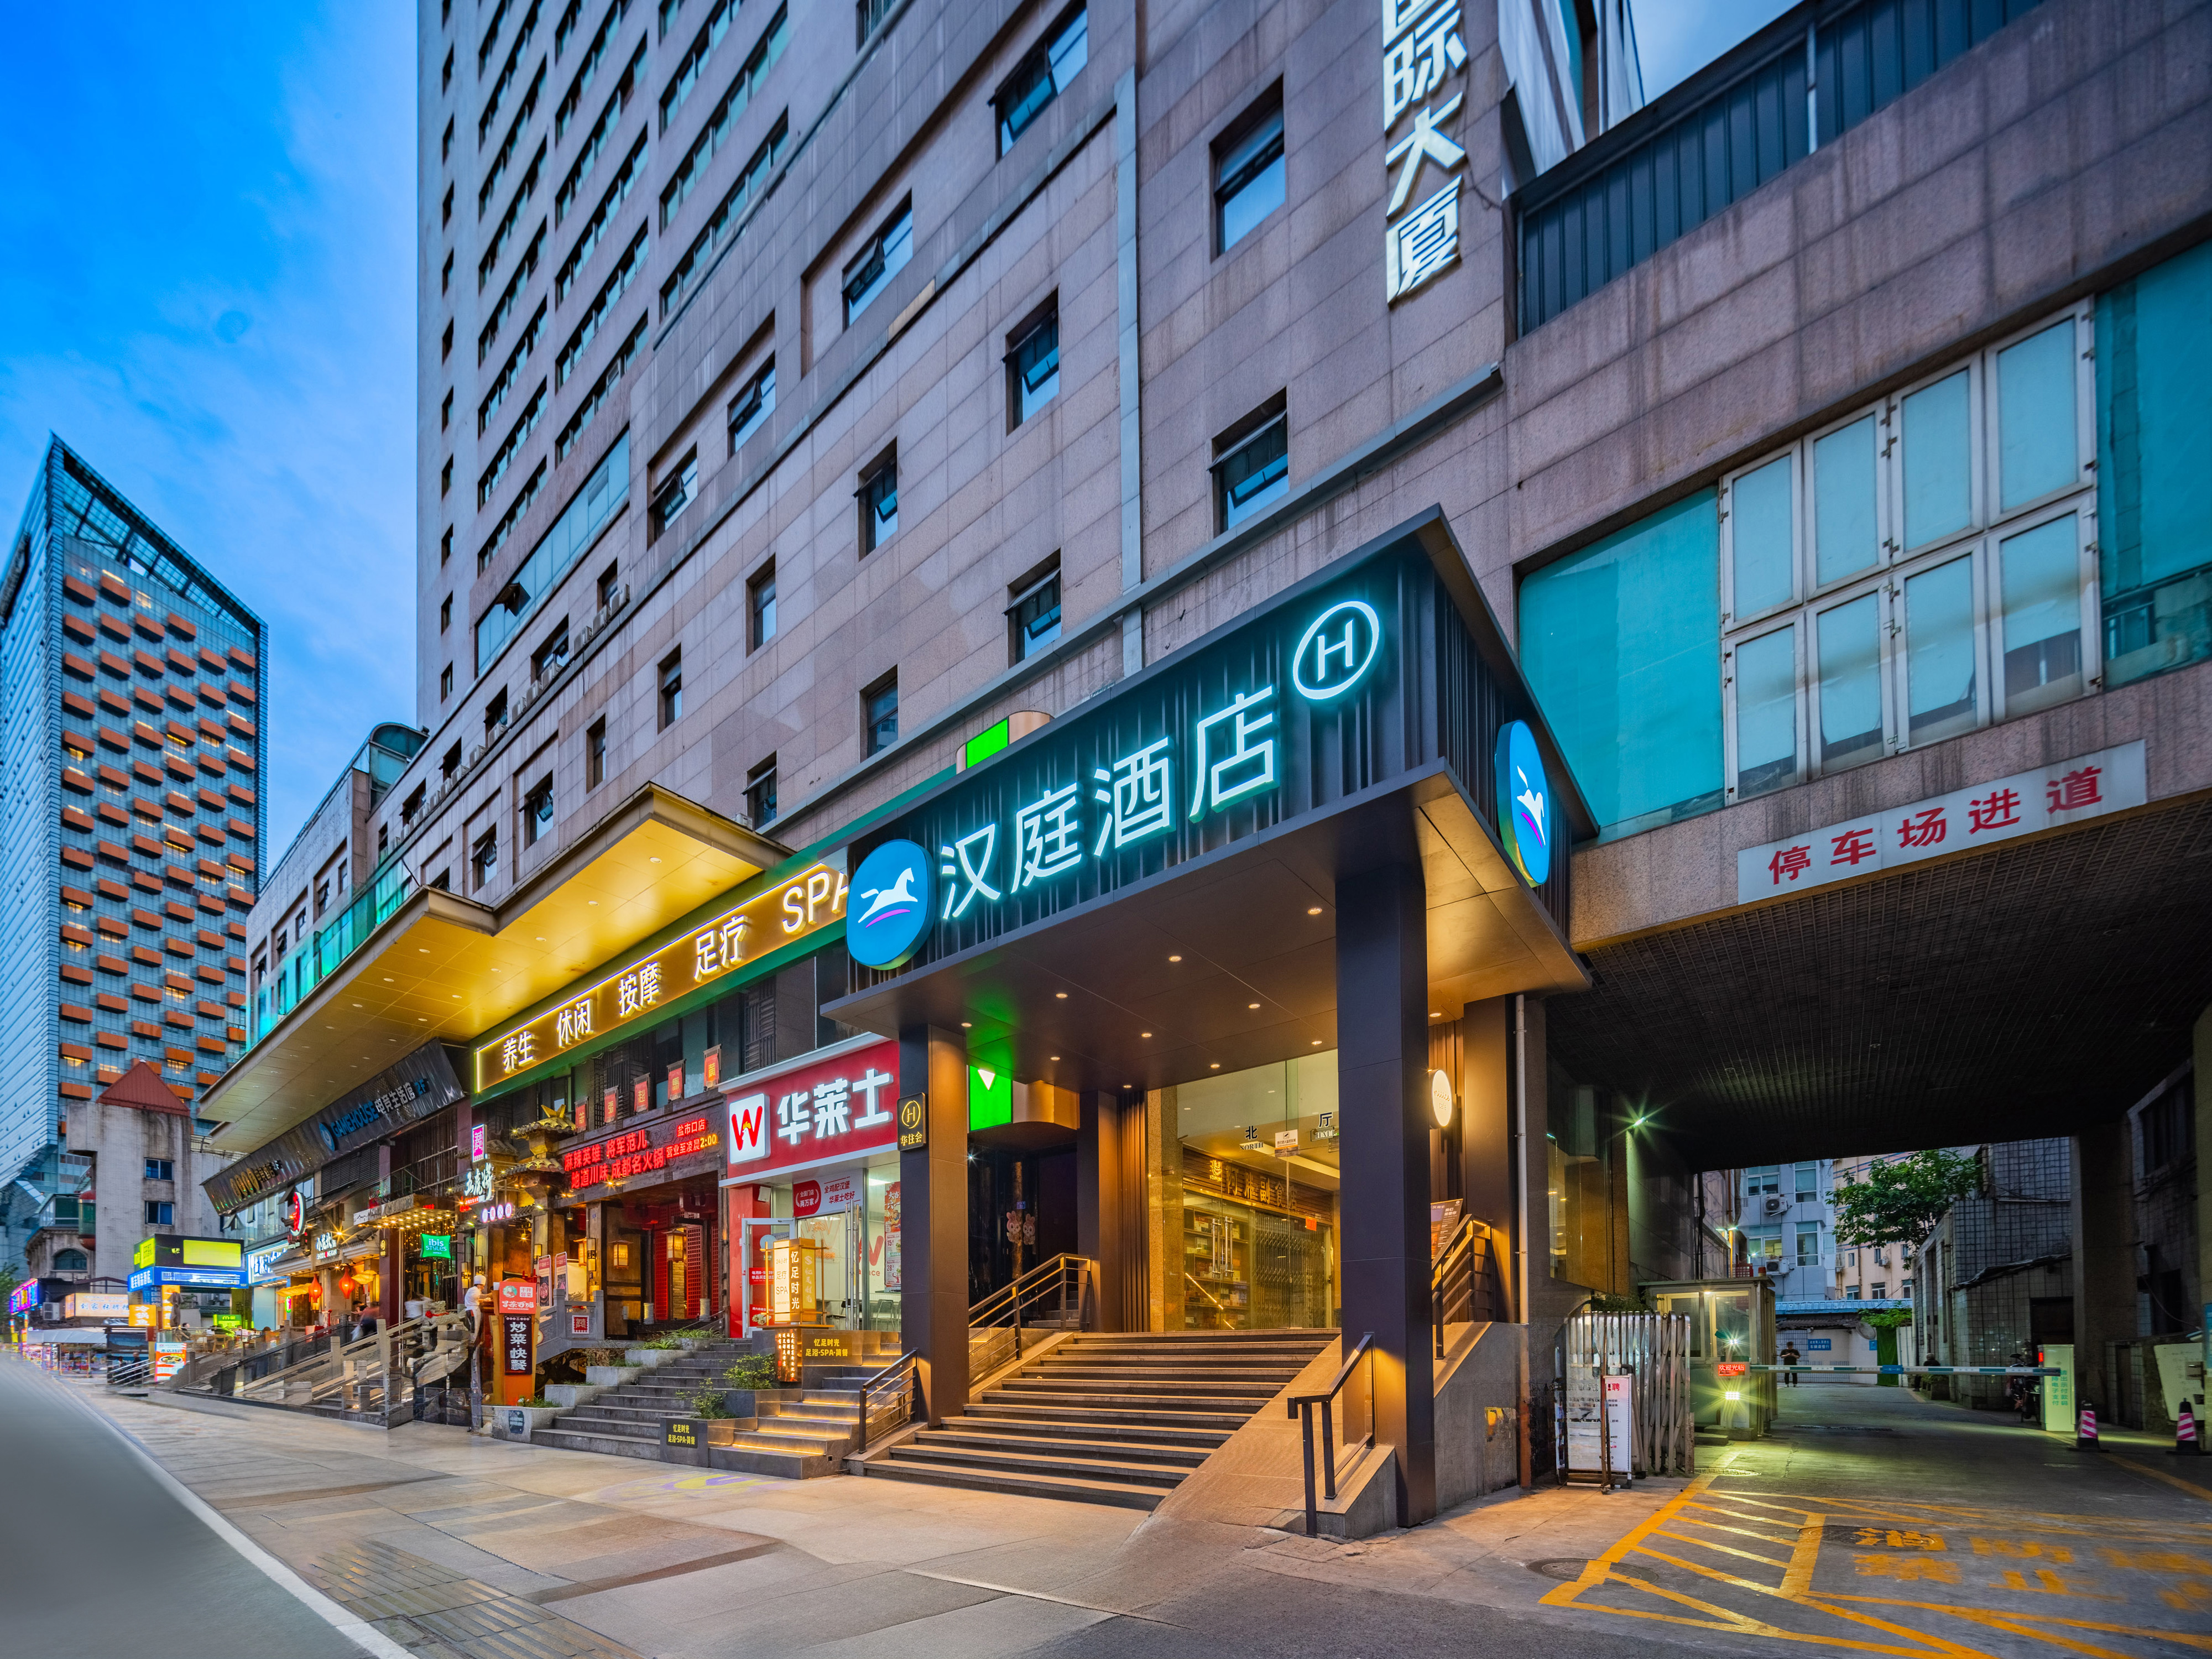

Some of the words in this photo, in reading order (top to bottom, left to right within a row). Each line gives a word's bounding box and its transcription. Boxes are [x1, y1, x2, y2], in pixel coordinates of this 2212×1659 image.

[941, 685, 1279, 920] 汉庭酒店
[1768, 766, 2102, 885] 停车场进道
[503, 1031, 535, 1073] 养生
[557, 998, 595, 1047] 休闲
[619, 962, 662, 1018] 按摩
[695, 915, 748, 982] 足疗
[331, 1100, 379, 1138] GAMEHOUSE
[374, 1082, 415, 1114] 电竞生活馆
[415, 1079, 427, 1095] 2F
[777, 1068, 894, 1145] 华莱士
[677, 1119, 706, 1137] 盐市口店
[731, 1105, 763, 1151] W
[1244, 1125, 1258, 1140] 北
[1318, 1112, 1333, 1128] 厅
[900, 1131, 922, 1146] 华住会
[1240, 1141, 1264, 1151] NORTH
[1315, 1129, 1336, 1139] HALL
[564, 1144, 601, 1171] 麻辣英雄
[571, 1163, 608, 1189] 地道川味
[611, 1147, 664, 1179] 成都名火锅
[800, 1189, 814, 1198] 全国门店
[824, 1181, 850, 1194] 全鸡配汉堡
[829, 1191, 855, 1204] 华莱士吃好
[800, 1199, 814, 1208] 两万家
[428, 1238, 444, 1246] ibis
[776, 1271, 787, 1280] 足疗
[791, 1251, 800, 1310] 忆足时光
[776, 1286, 789, 1295] SPA
[135, 1305, 150, 1326] 冷锅鱼
[805, 1348, 848, 1357] 足浴·SPA·简餐
[813, 1338, 840, 1347] 忆足时光
[2051, 1376, 2059, 1406] 持电子支付
[672, 1424, 690, 1433] 忆足时光
